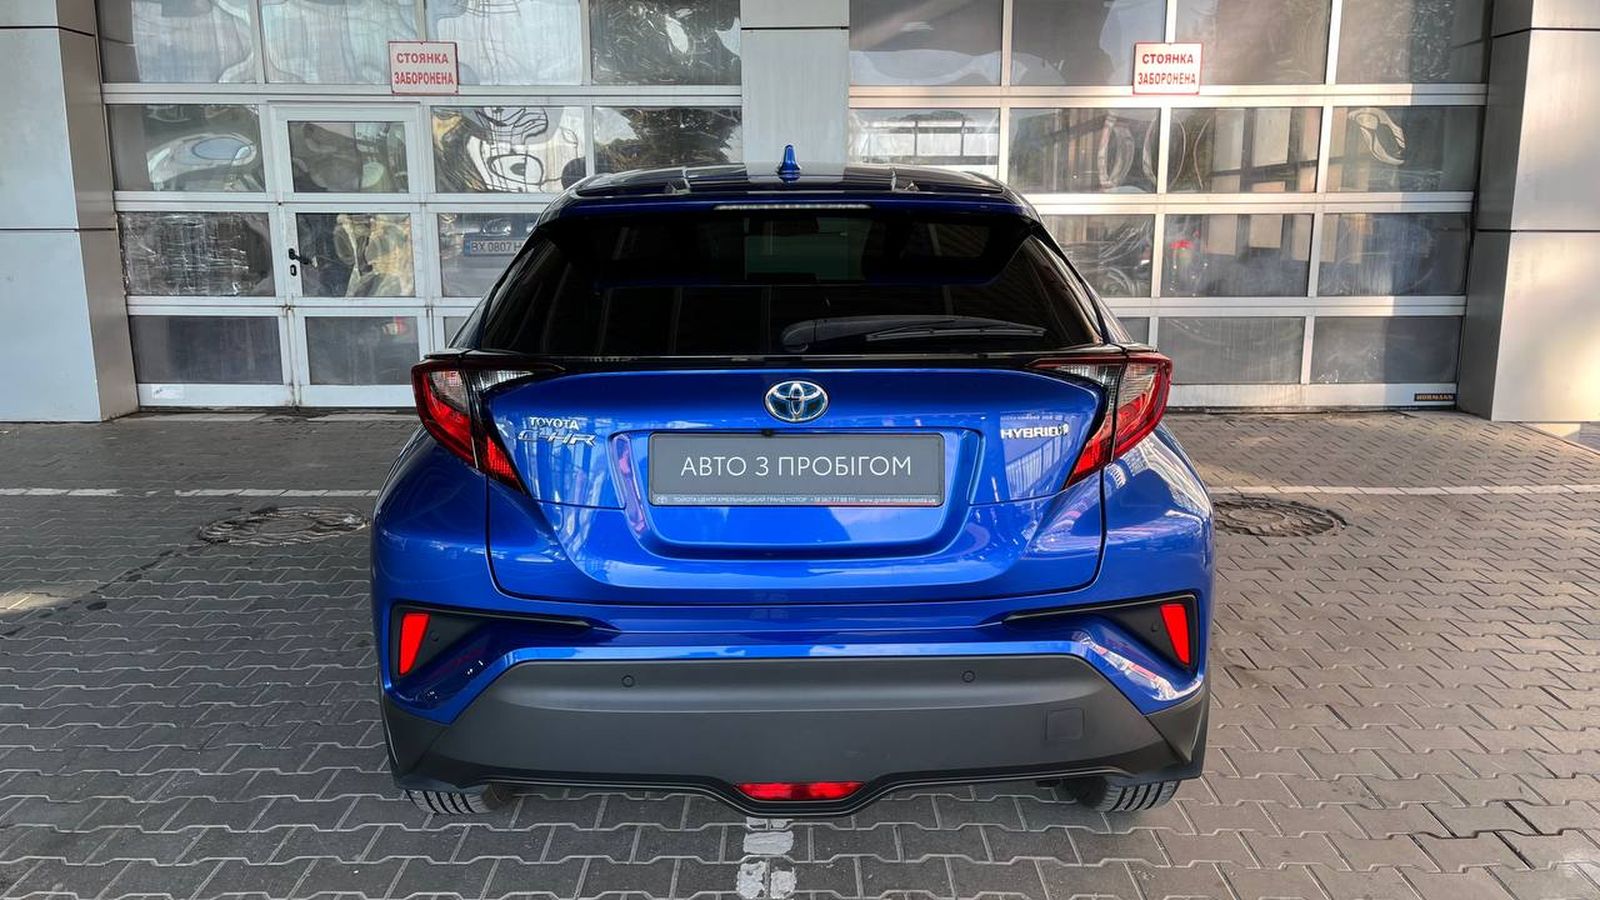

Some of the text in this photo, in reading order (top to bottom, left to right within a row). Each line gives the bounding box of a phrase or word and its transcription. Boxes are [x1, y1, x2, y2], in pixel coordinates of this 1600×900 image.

[396, 53, 449, 63] СТОЯНКА
[1142, 53, 1194, 64] СТОЯНКА
[394, 72, 454, 85] ЗАБОРОНЕНА
[1138, 72, 1196, 85] ЗАБОРОНЕНА
[529, 416, 580, 430] TOYOTA
[518, 430, 596, 448] C-HR
[999, 426, 1061, 439] HYBRID
[681, 456, 912, 476] АВТО З ПРОБІГОМ
